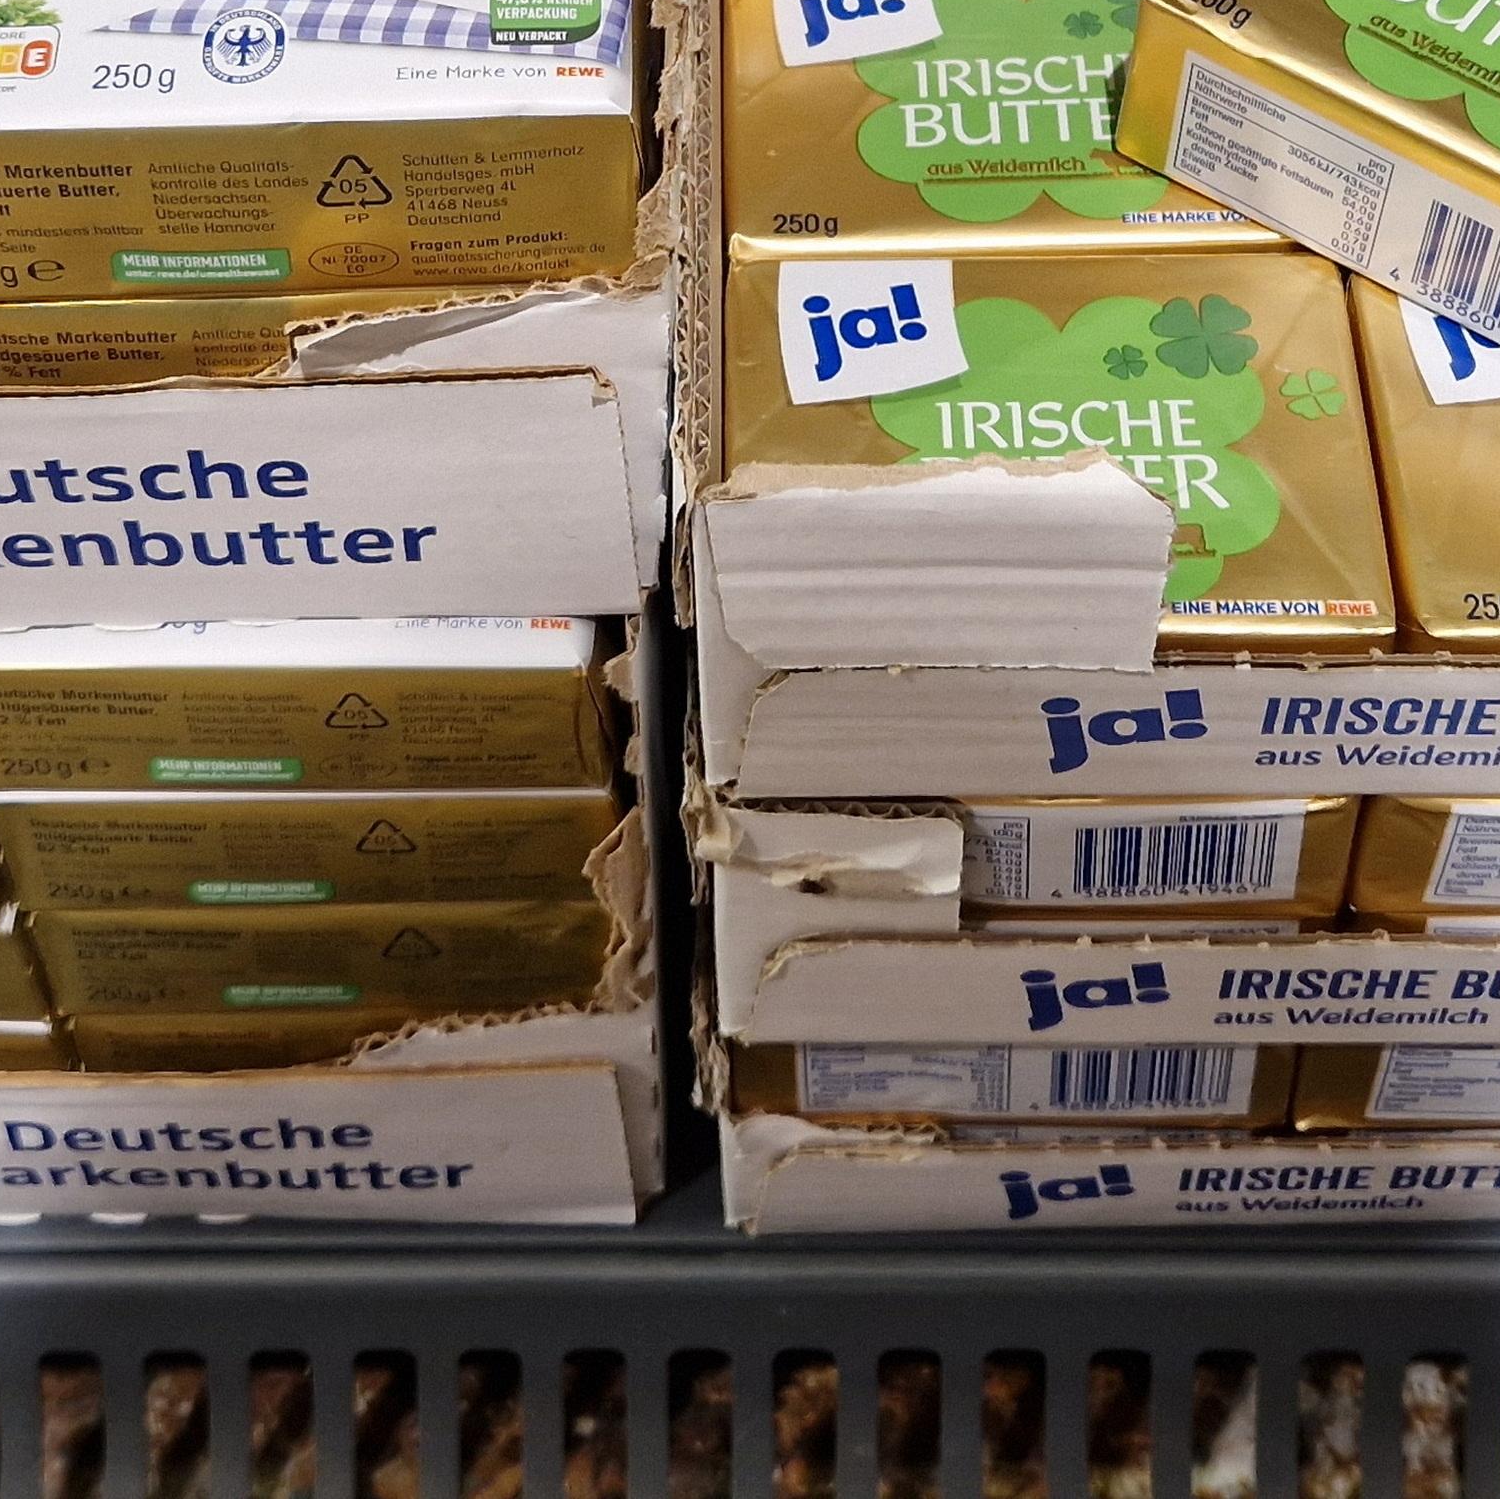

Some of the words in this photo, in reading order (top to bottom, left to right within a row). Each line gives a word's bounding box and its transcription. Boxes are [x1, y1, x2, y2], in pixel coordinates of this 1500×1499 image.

[496, 7, 578, 21] VERPACKUNG
[1231, 9, 1252, 30] g
[496, 31, 516, 42] NEU
[517, 30, 567, 41] VERPACKT
[396, 66, 440, 80] Eine
[446, 64, 505, 79] Marke
[512, 67, 546, 78] von
[556, 66, 604, 78] REWE
[1196, 71, 1286, 124] Durchschnittliche
[1192, 97, 1244, 129] Brennwert
[1368, 159, 1387, 174] pro
[151, 177, 218, 190] kontrolle
[222, 176, 250, 188] des
[254, 175, 308, 188] Landes
[339, 178, 367, 194] 05
[407, 200, 457, 211] 41468
[462, 198, 508, 209] Neuss
[159, 222, 199, 234] stelle
[204, 220, 275, 233] Hannover
[407, 211, 500, 226] Deutschland
[411, 239, 462, 251] Fragen
[468, 239, 499, 248] zum
[506, 232, 568, 245] Produkt:
[123, 253, 159, 267] MEHR
[162, 253, 266, 267] INFORMATIONEN
[1389, 267, 1401, 282] 4
[1416, 281, 1496, 331] 388860
[804, 284, 921, 383] ja!
[935, 400, 1202, 449] IRISCHE
[1257, 699, 1500, 737] IRISCHE
[1042, 691, 1210, 774] ja!
[1255, 748, 1322, 768] aus
[1218, 968, 1439, 999] IRISCHE
[1020, 961, 1171, 1032] ja!
[1214, 1011, 1273, 1026] aus
[1287, 1006, 1489, 1026] Weidemilch
[2, 1119, 374, 1159] Deutsche
[1000, 1164, 1134, 1220] ja!
